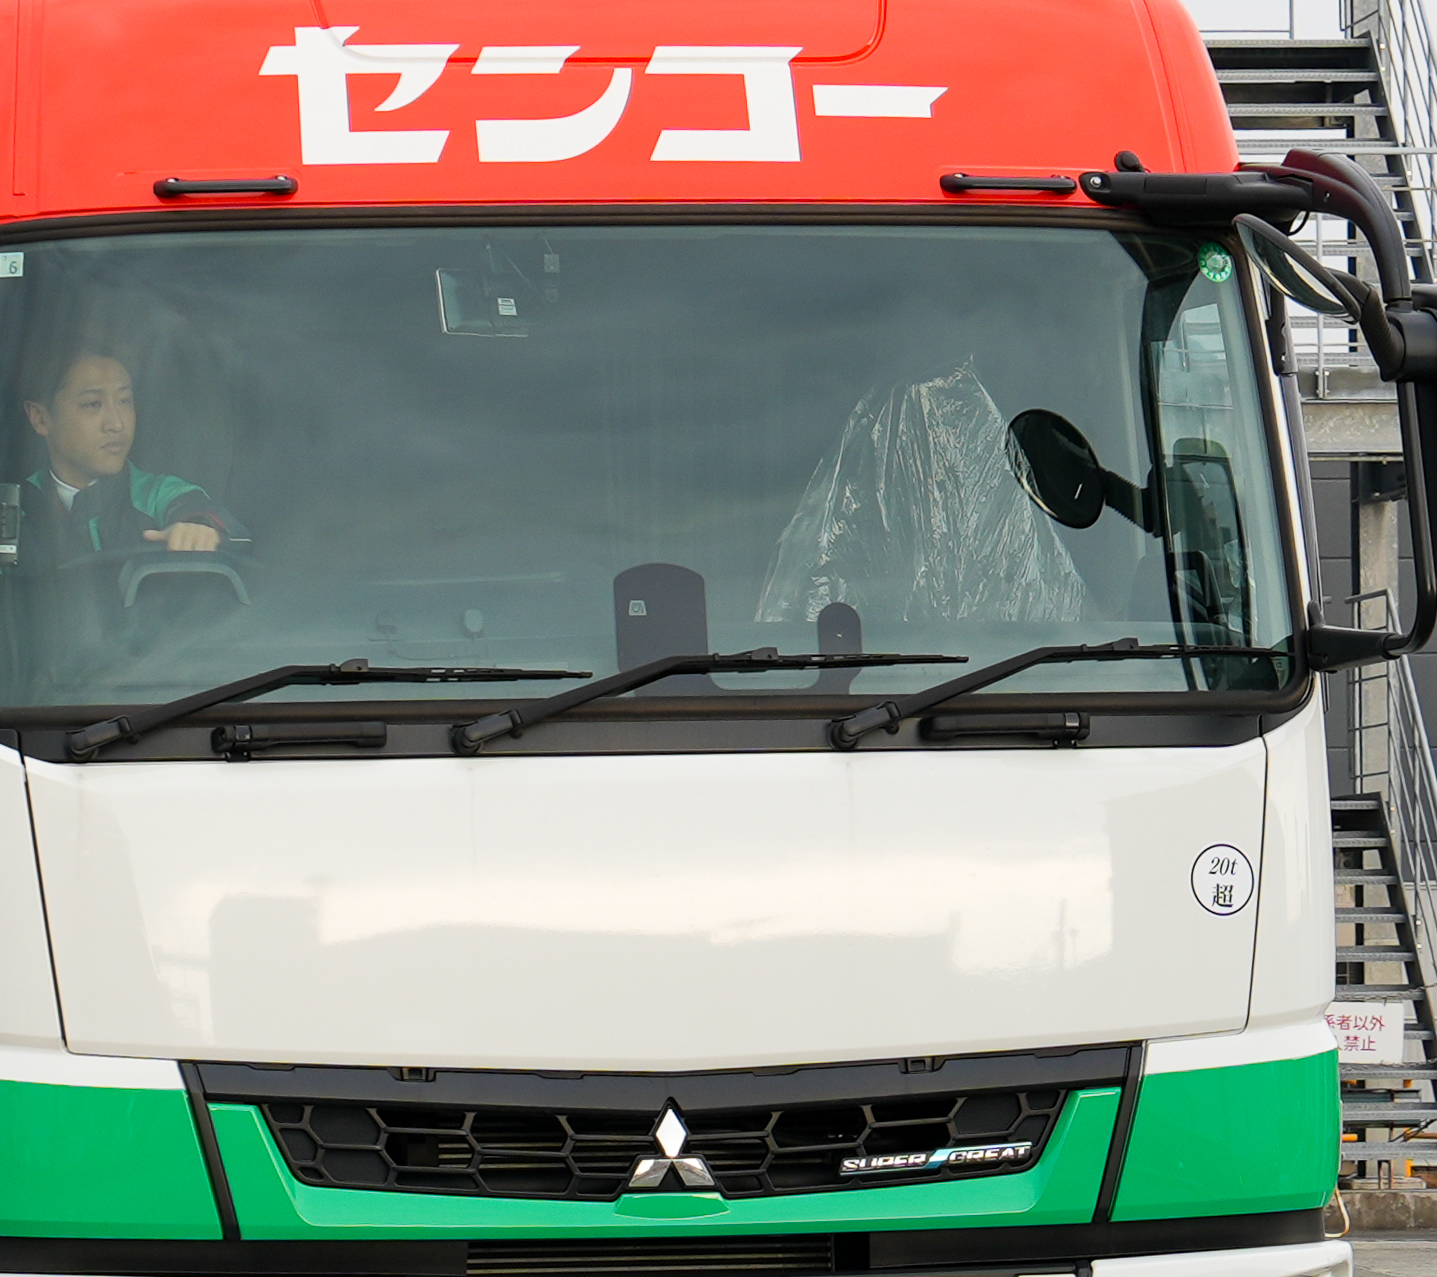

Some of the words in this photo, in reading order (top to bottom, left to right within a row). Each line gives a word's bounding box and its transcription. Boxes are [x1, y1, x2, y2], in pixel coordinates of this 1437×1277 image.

[258, 26, 949, 165] センコー
[1208, 856, 1238, 876] 20t
[1212, 883, 1234, 907] 超
[1338, 1035, 1377, 1052] 禁止
[842, 1153, 928, 1172] SUPER
[948, 1145, 1031, 1165] GREAT
